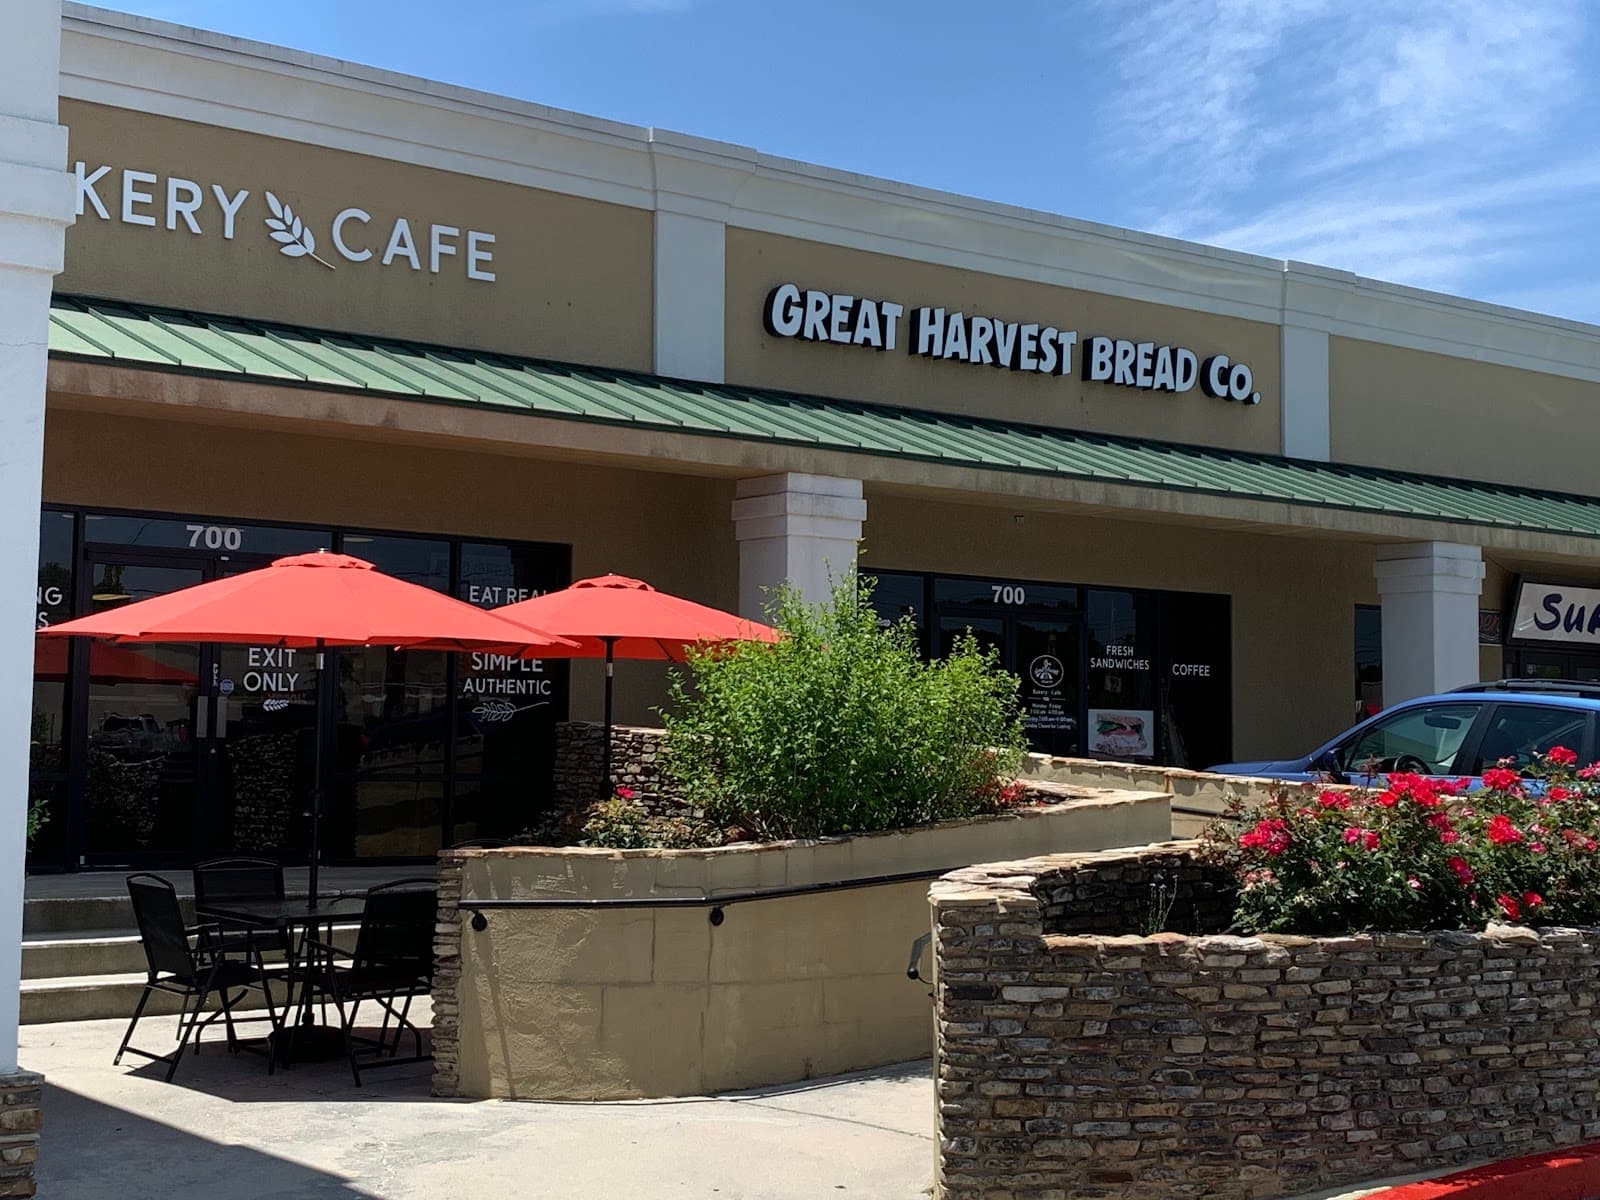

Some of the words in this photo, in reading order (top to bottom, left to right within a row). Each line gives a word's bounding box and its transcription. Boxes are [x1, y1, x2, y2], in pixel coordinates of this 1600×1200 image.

[332, 207, 496, 282] CAFE
[765, 283, 904, 351] GREAT
[909, 306, 1078, 376] HARVEST
[1083, 336, 1198, 393] BREAD
[186, 524, 242, 551] 700
[469, 586, 502, 604] EAT
[991, 585, 1025, 605] 700
[248, 647, 297, 668] EXIT
[1106, 645, 1134, 656] FRESH
[471, 652, 544, 672] SIMPLE
[1090, 657, 1150, 670] SANDWICHES
[1172, 663, 1211, 677] COFFEE
[243, 671, 299, 692] ONLY
[463, 677, 552, 695] AUTHENTIC
